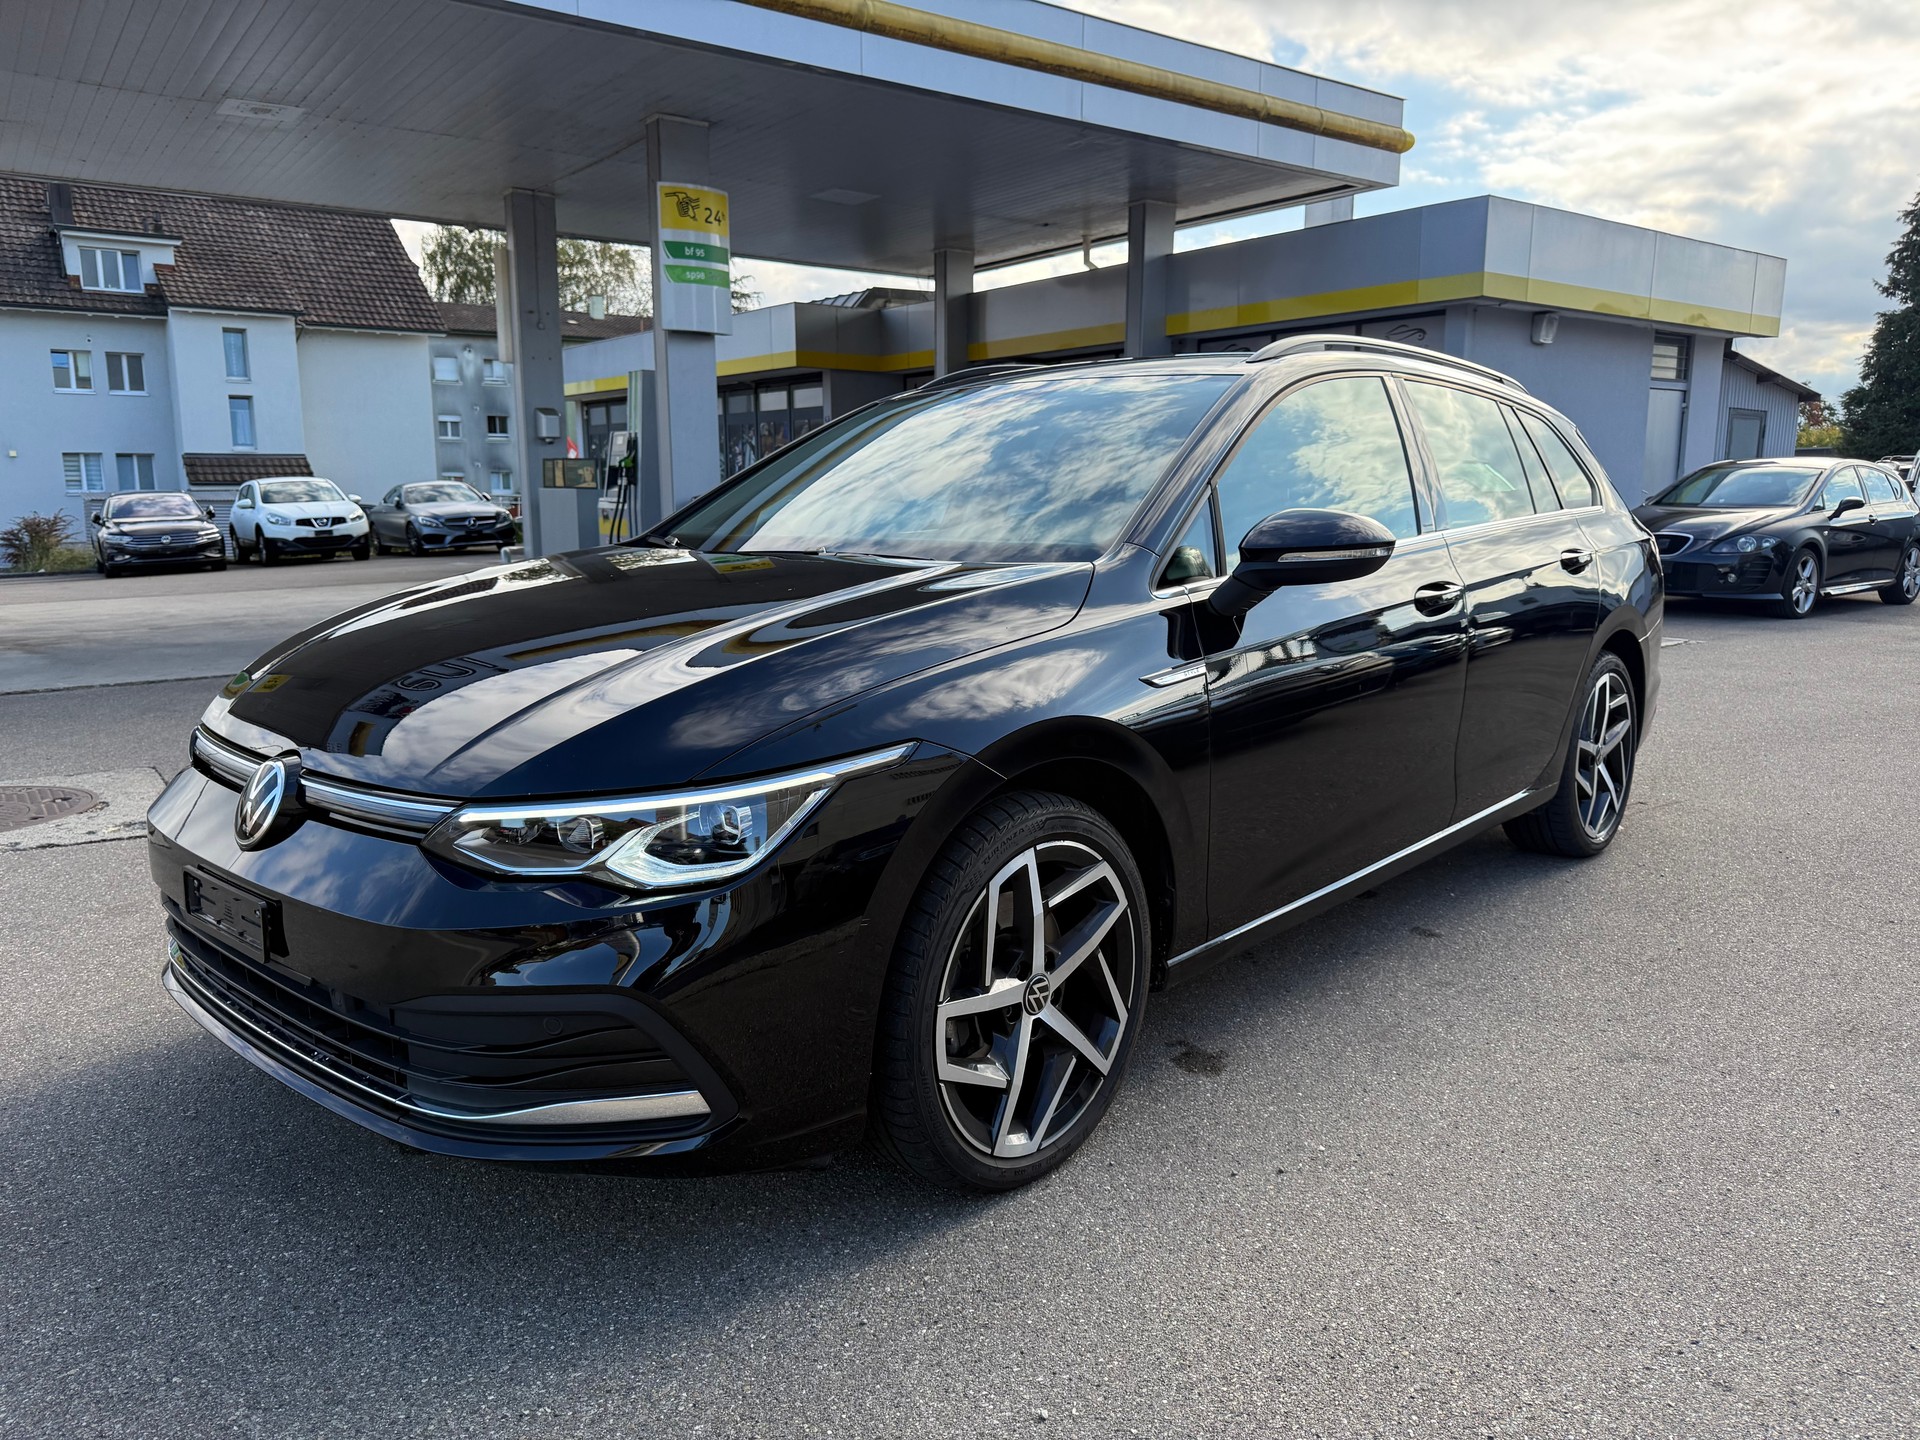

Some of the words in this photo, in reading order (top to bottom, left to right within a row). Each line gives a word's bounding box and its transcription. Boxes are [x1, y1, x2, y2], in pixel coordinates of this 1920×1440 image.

[685, 246, 694, 256] bf
[695, 248, 705, 257] 95
[685, 271, 705, 281] sp98
[982, 828, 1025, 865] TURANZA
